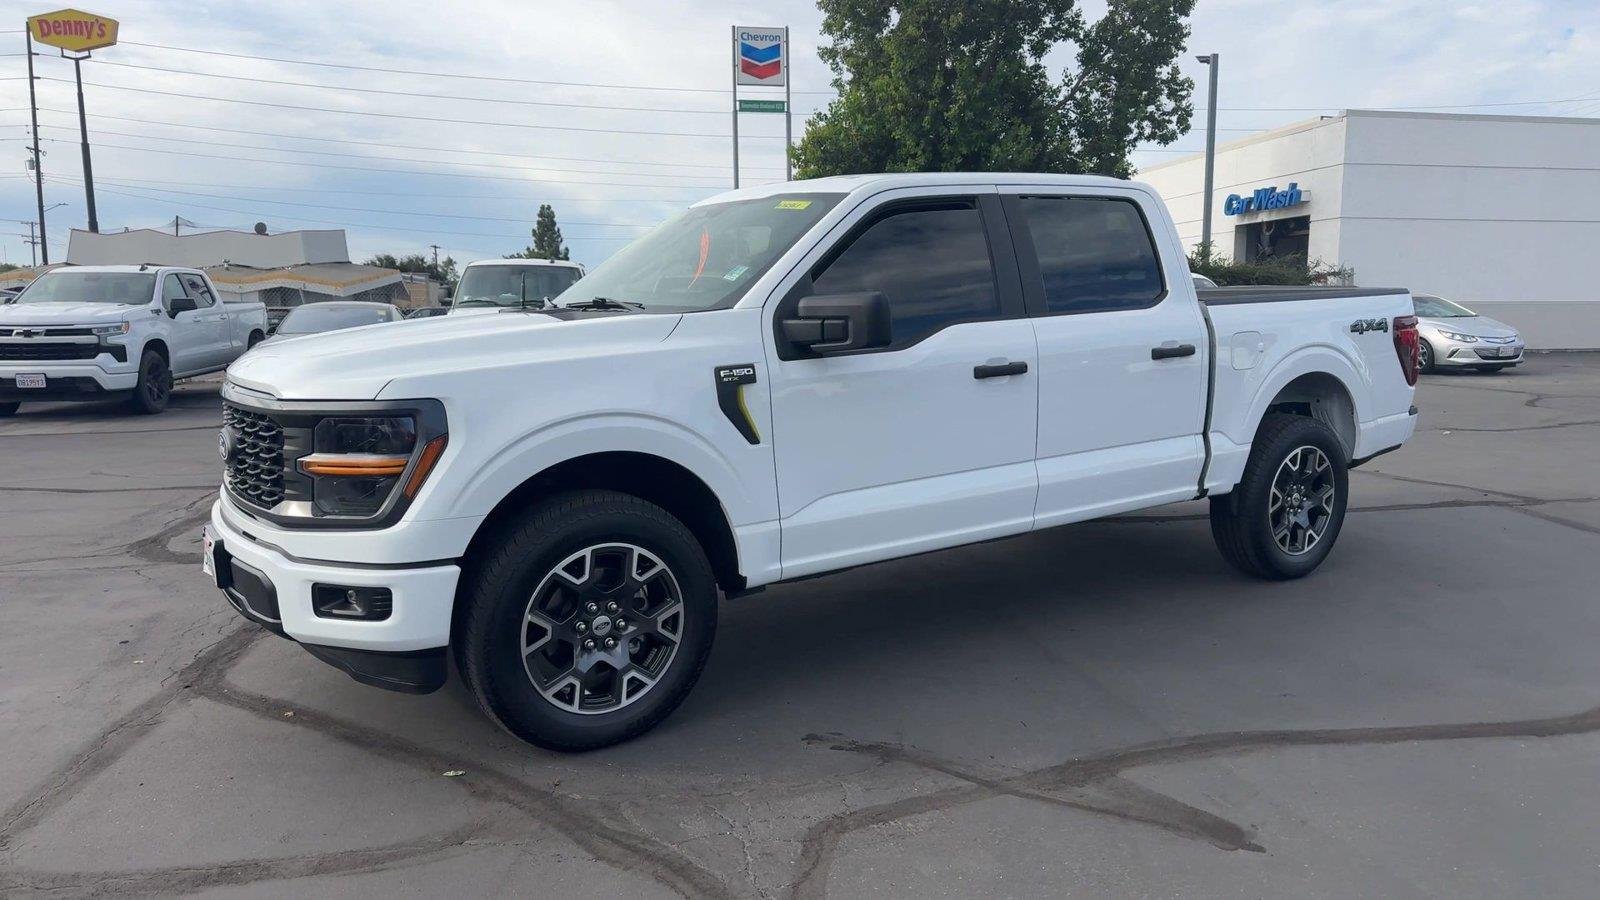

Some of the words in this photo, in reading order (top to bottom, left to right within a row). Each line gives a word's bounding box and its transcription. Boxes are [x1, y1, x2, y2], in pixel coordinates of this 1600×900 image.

[37, 18, 106, 39] Denny's
[740, 32, 781, 42] Chevron
[720, 368, 754, 377] F-150
